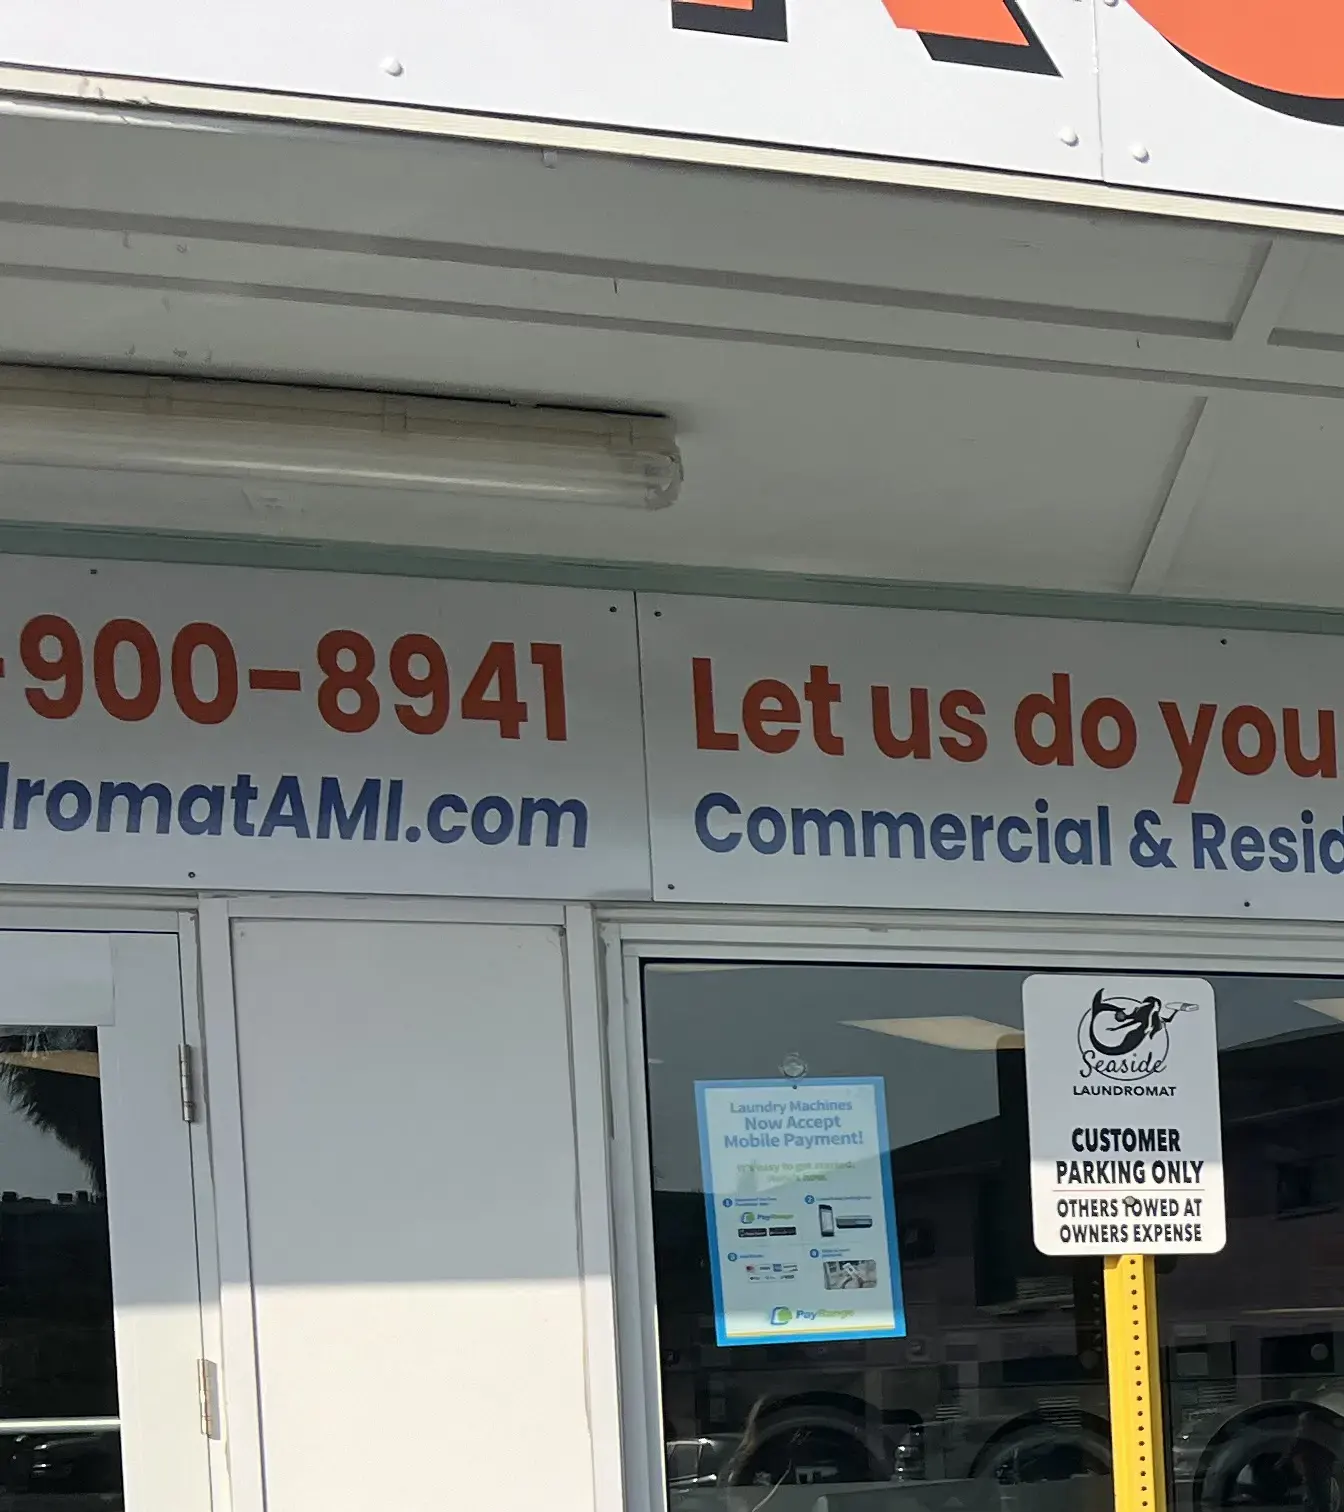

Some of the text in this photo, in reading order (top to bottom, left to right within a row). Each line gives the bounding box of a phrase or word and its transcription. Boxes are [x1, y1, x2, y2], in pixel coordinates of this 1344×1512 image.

[0, 613, 568, 741] 900-8941
[692, 657, 844, 756] Let
[870, 685, 988, 763] us
[1014, 672, 1137, 769] do
[695, 792, 1112, 867] Commercial
[1129, 809, 1177, 869] &
[1080, 1050, 1168, 1078] Seaside
[1073, 1085, 1177, 1097] LAUNDROMAT
[730, 1100, 852, 1115] Laundry Machines
[745, 1115, 841, 1131] Now Accept
[724, 1131, 863, 1149] Mobile Payment!
[1072, 1127, 1181, 1153] CUSTOMER
[1056, 1160, 1204, 1184] PARKING ONLY
[1057, 1198, 1118, 1218] OTHERS
[1184, 1198, 1202, 1217] AT
[1060, 1224, 1202, 1243] OWNERS EXPENSE
